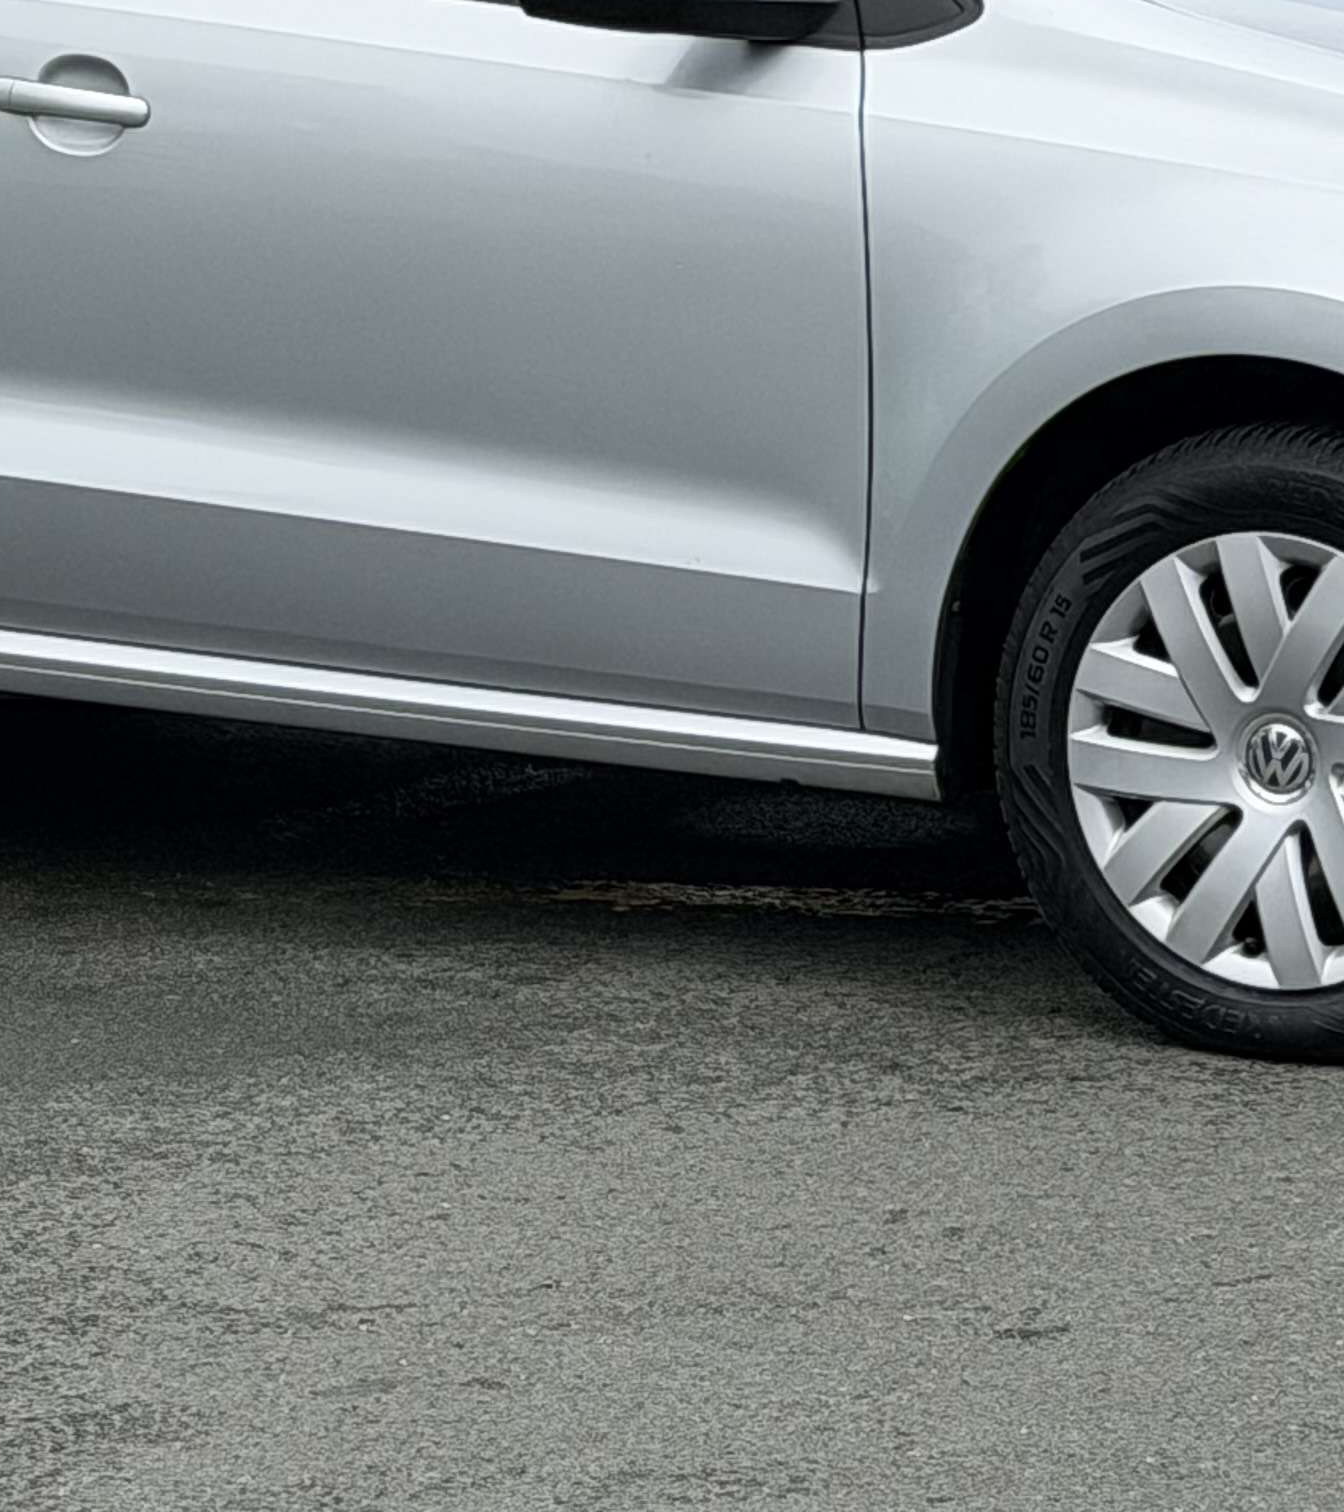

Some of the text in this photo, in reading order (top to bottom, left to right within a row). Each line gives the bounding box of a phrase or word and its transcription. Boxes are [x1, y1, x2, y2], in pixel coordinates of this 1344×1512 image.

[1020, 591, 1074, 740] 185/60 R 15
